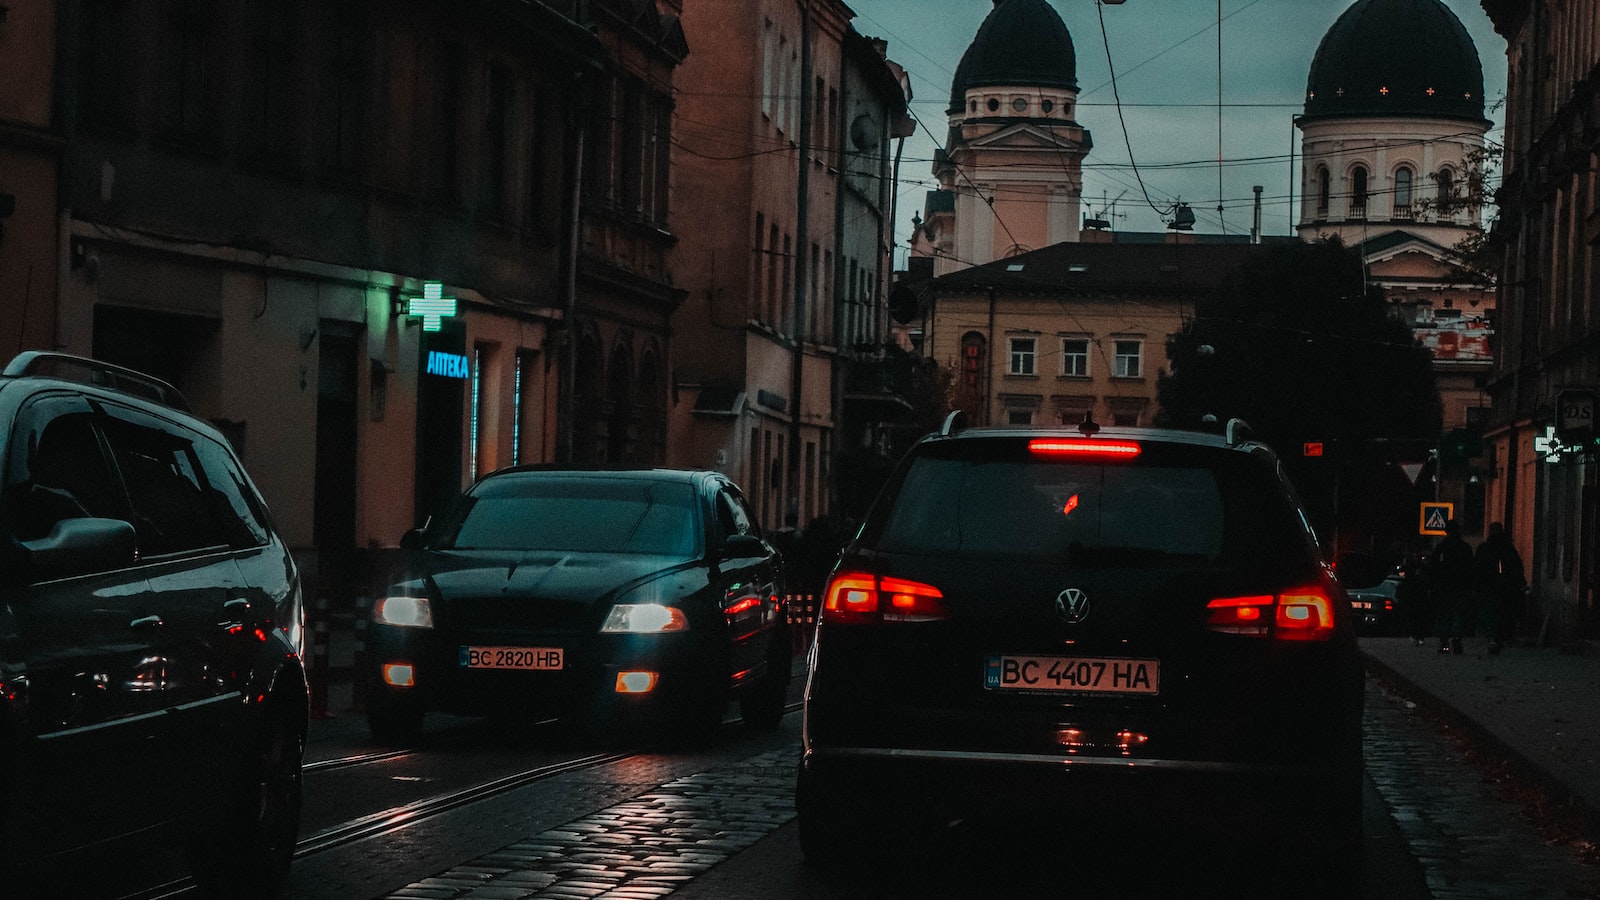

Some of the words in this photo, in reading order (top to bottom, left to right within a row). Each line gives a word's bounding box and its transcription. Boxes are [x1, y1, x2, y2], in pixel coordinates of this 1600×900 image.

[427, 350, 469, 379] АПТЕКА
[469, 650, 492, 666] BC
[496, 651, 533, 667] 2820
[537, 651, 561, 667] HB
[987, 675, 1000, 685] UA
[1002, 659, 1039, 685] BC
[1047, 660, 1105, 687] 4407
[1113, 662, 1150, 689] HA
